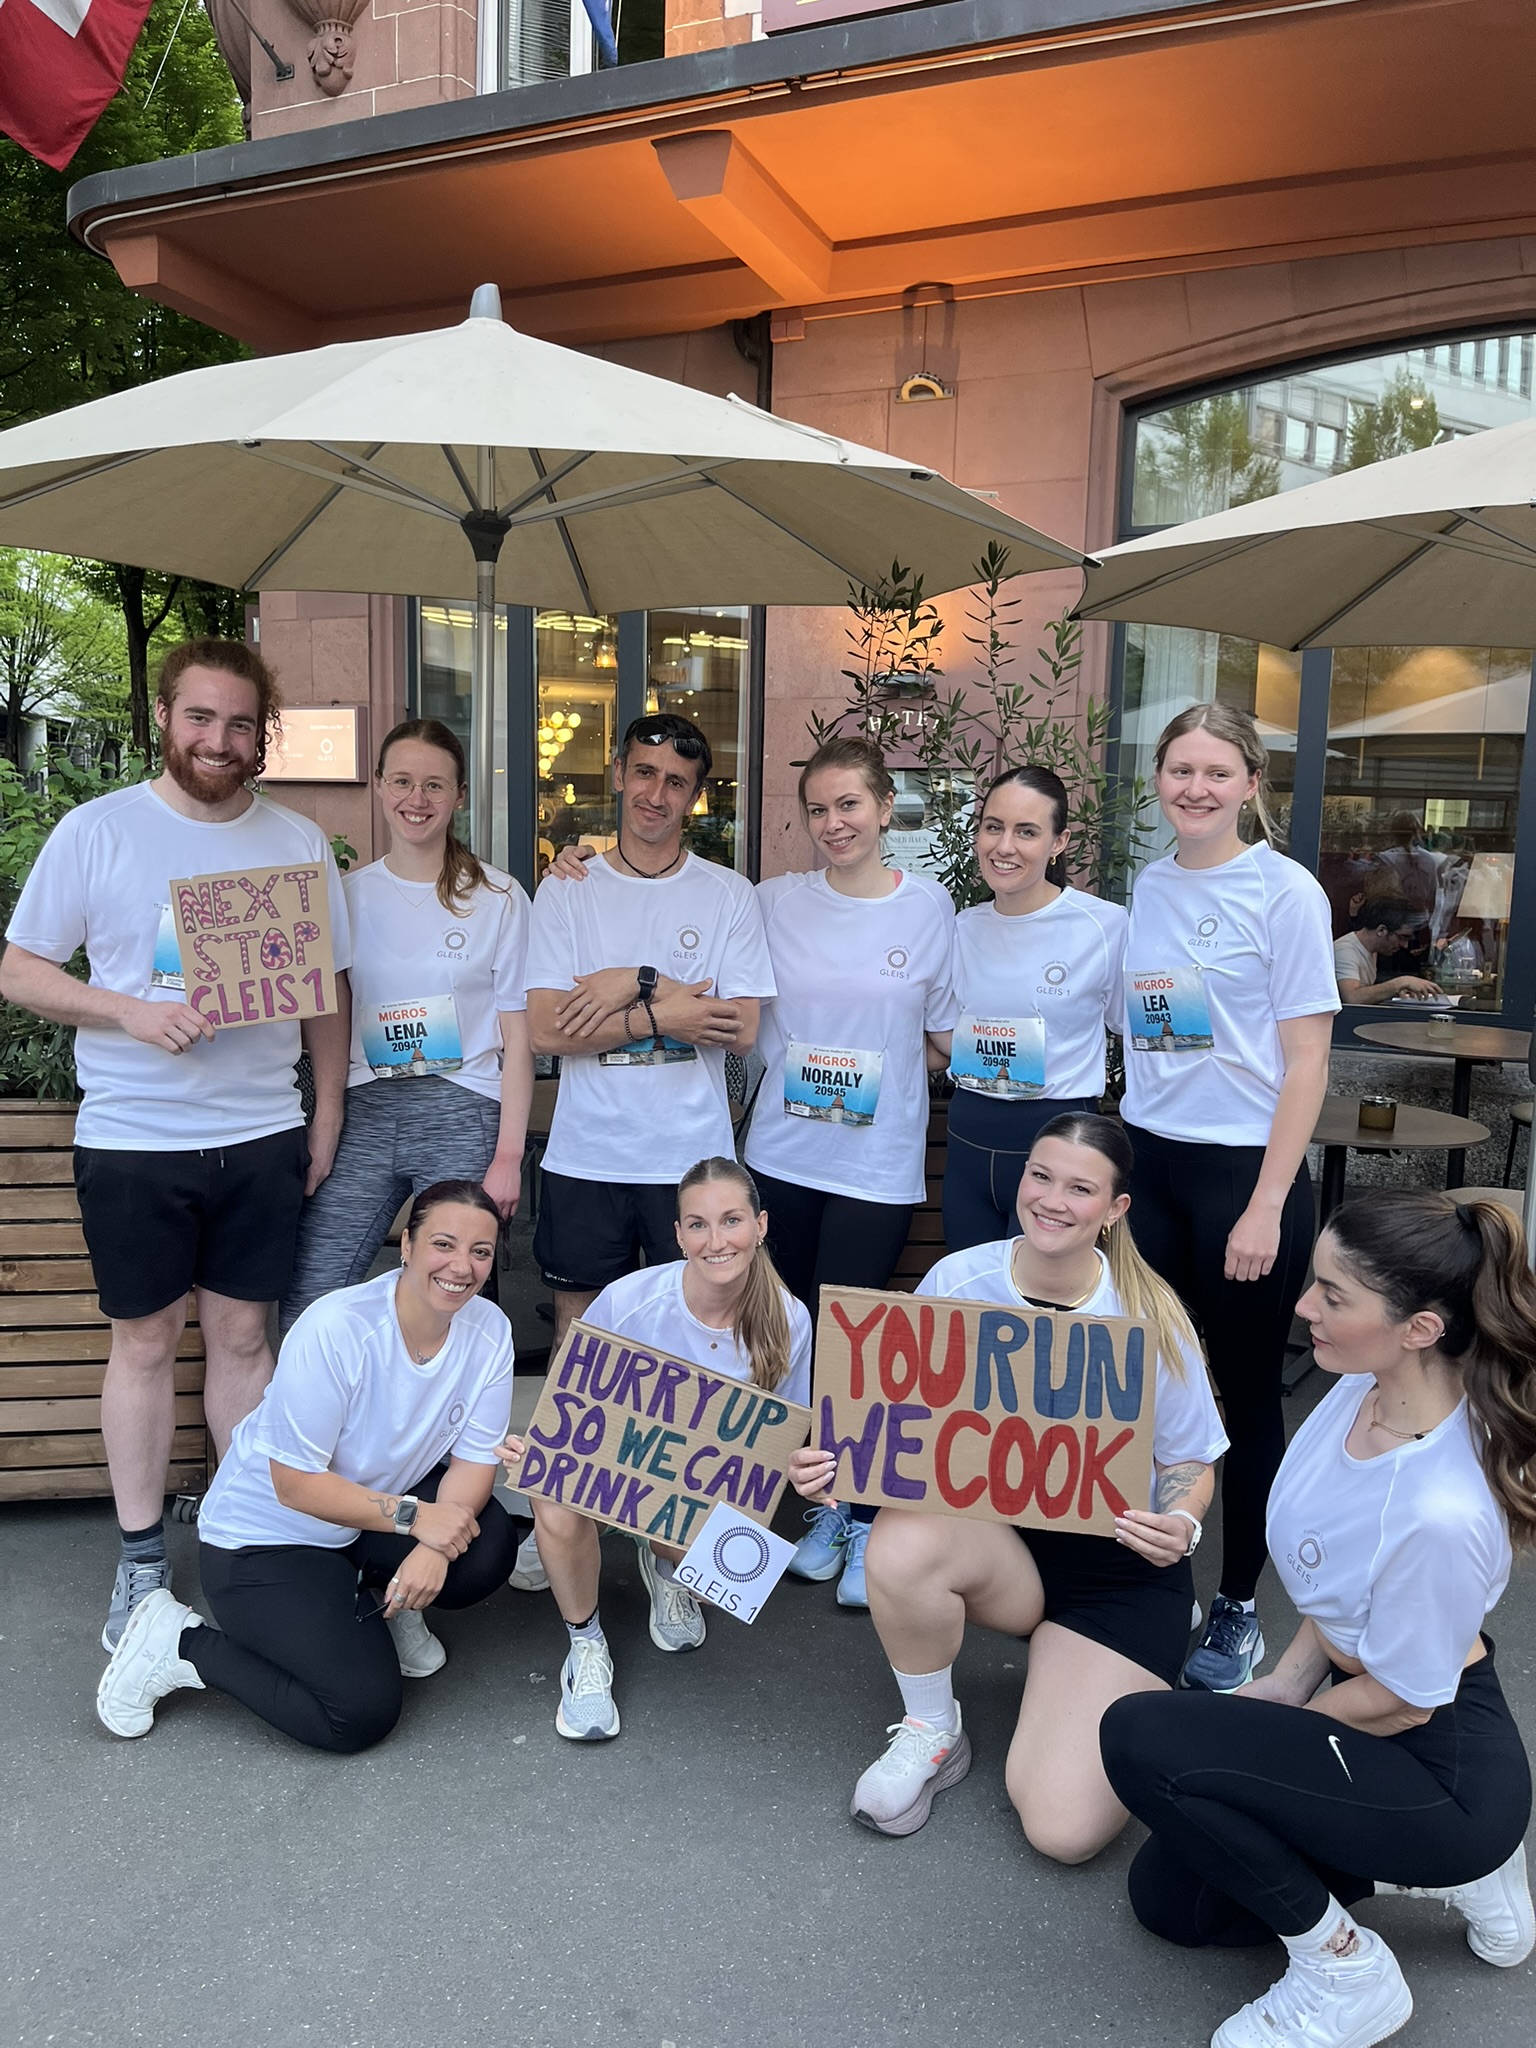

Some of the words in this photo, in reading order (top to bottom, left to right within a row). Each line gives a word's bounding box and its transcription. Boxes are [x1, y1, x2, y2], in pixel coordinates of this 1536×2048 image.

[177, 870, 319, 934] NEXT
[193, 920, 320, 983] STOP
[1187, 938, 1211, 948] GLEIS
[1214, 941, 1218, 949] 1
[436, 950, 463, 961] GLEIS
[672, 950, 698, 960] GLEIS
[879, 968, 905, 979] GLEIS
[906, 973, 910, 981] 1
[1036, 985, 1063, 996] GLEIS
[1066, 989, 1070, 997] 1
[1133, 977, 1175, 991] MIGROS
[190, 973, 299, 1025] GLEIS
[302, 967, 325, 1012] 1
[1142, 994, 1170, 1012] LEA
[378, 1006, 428, 1022] MIGROS
[1145, 1012, 1172, 1024] 20943
[384, 1021, 428, 1042] LENA
[972, 1024, 1017, 1037] MIGROS
[391, 1039, 423, 1053] 20947
[975, 1039, 1017, 1057] ALINE
[807, 1053, 857, 1068] MIGROS
[982, 1056, 1010, 1068] 20948
[801, 1066, 864, 1088] NORALY
[814, 1085, 847, 1098] 20945
[830, 1300, 966, 1408] YOU
[974, 1310, 1145, 1422] RUN
[557, 1331, 725, 1430] HURRY
[717, 1387, 789, 1449] UP
[529, 1392, 606, 1455] SO
[616, 1417, 687, 1482] WE
[684, 1445, 782, 1513] CAN
[820, 1395, 932, 1500] WE
[935, 1410, 1135, 1519] COOK
[518, 1445, 654, 1528] DRINK
[645, 1493, 710, 1545] AT
[1286, 1553, 1312, 1584] GLEIS
[1312, 1583, 1319, 1592] 1
[679, 1566, 742, 1612] GLEIS
[747, 1606, 758, 1622] 1
